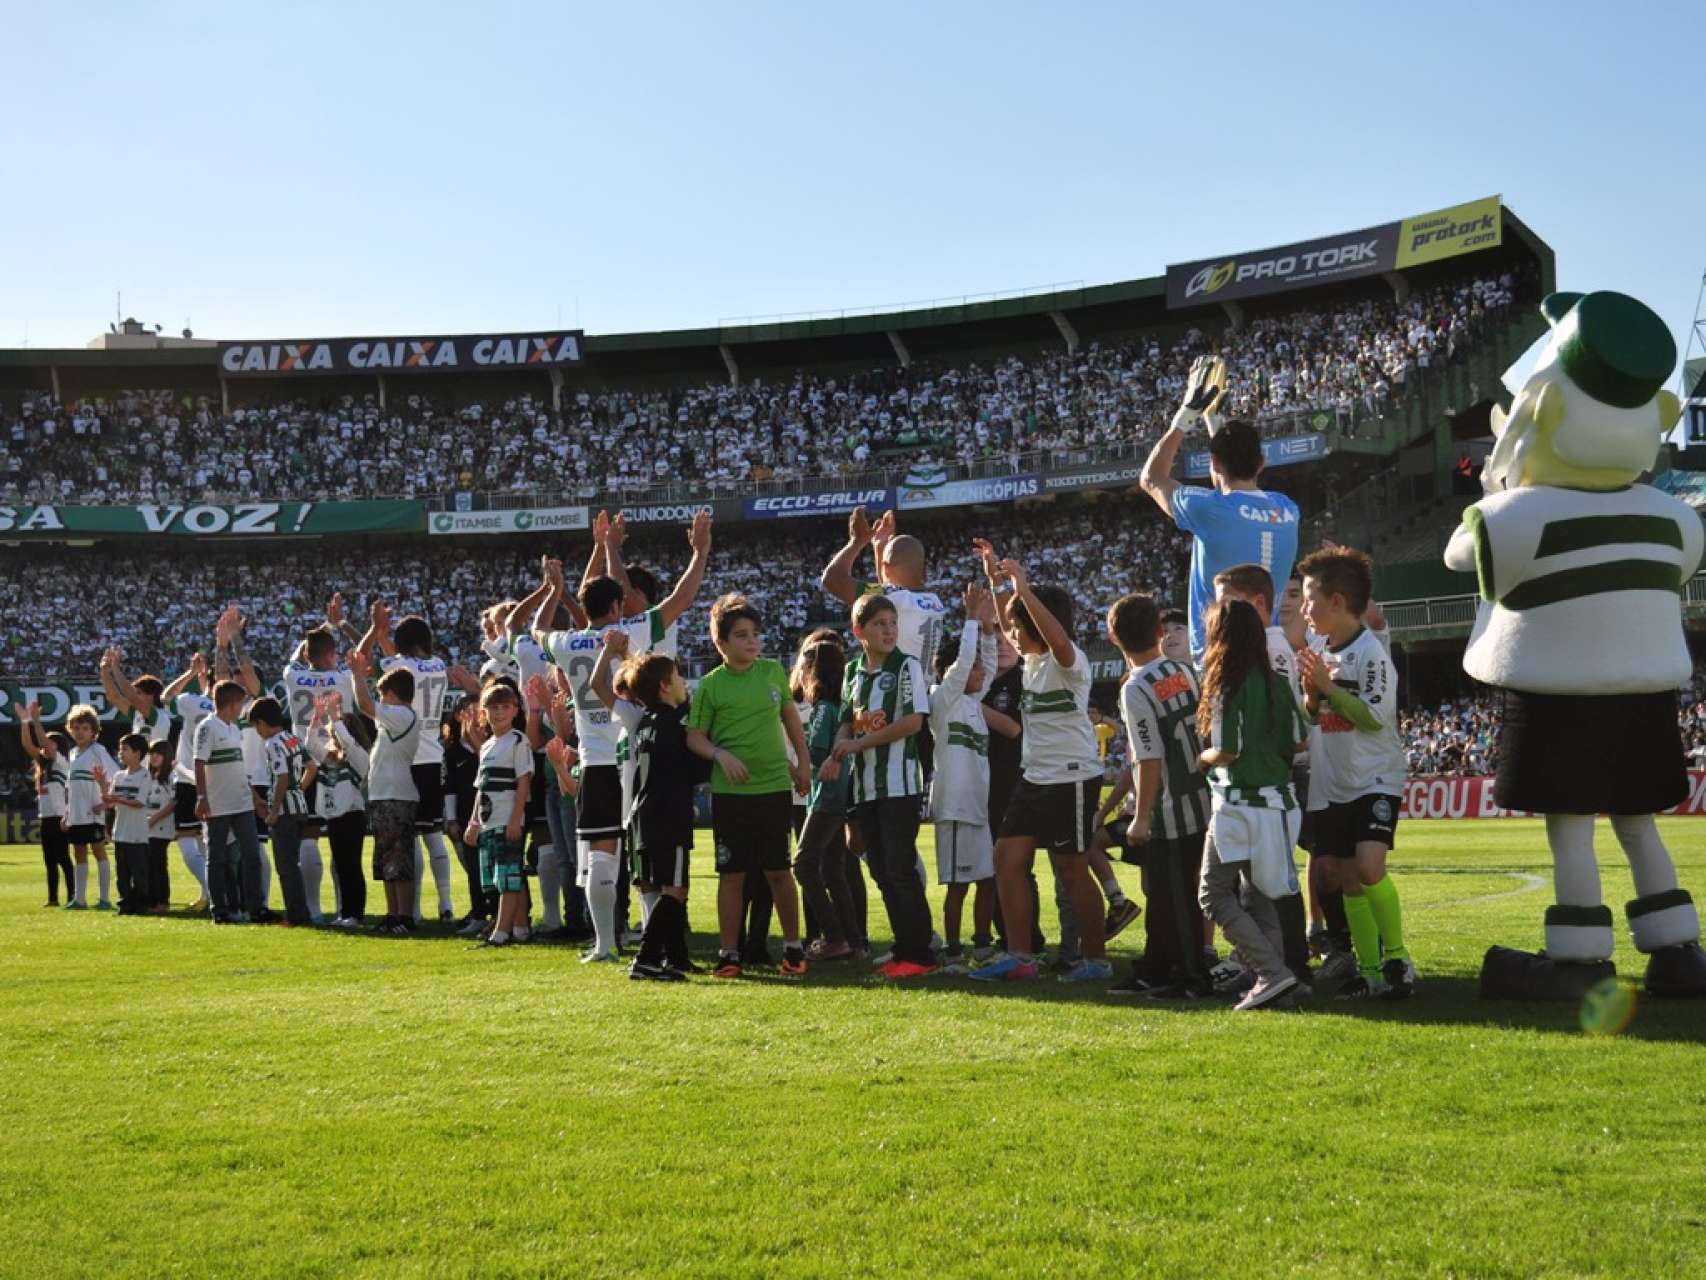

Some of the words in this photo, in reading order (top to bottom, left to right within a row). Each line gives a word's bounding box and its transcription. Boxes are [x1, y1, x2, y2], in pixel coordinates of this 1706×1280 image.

[1411, 214, 1495, 252] protork
[1235, 257, 1296, 282] PRO
[1303, 240, 1379, 270] TORK
[222, 344, 334, 371] CAIXA
[348, 341, 457, 368] CAIXA
[472, 336, 579, 365] CAIXA
[1280, 437, 1318, 455] NET
[1190, 454, 1211, 469] NE
[455, 515, 502, 530] ITAMBÉ
[535, 512, 582, 527] ITAMBÉ
[1240, 505, 1295, 524] CAIXA
[1260, 531, 1273, 572] 1
[570, 637, 606, 651] CAIX
[296, 677, 337, 688] CAIXA
[418, 675, 447, 719] 17
